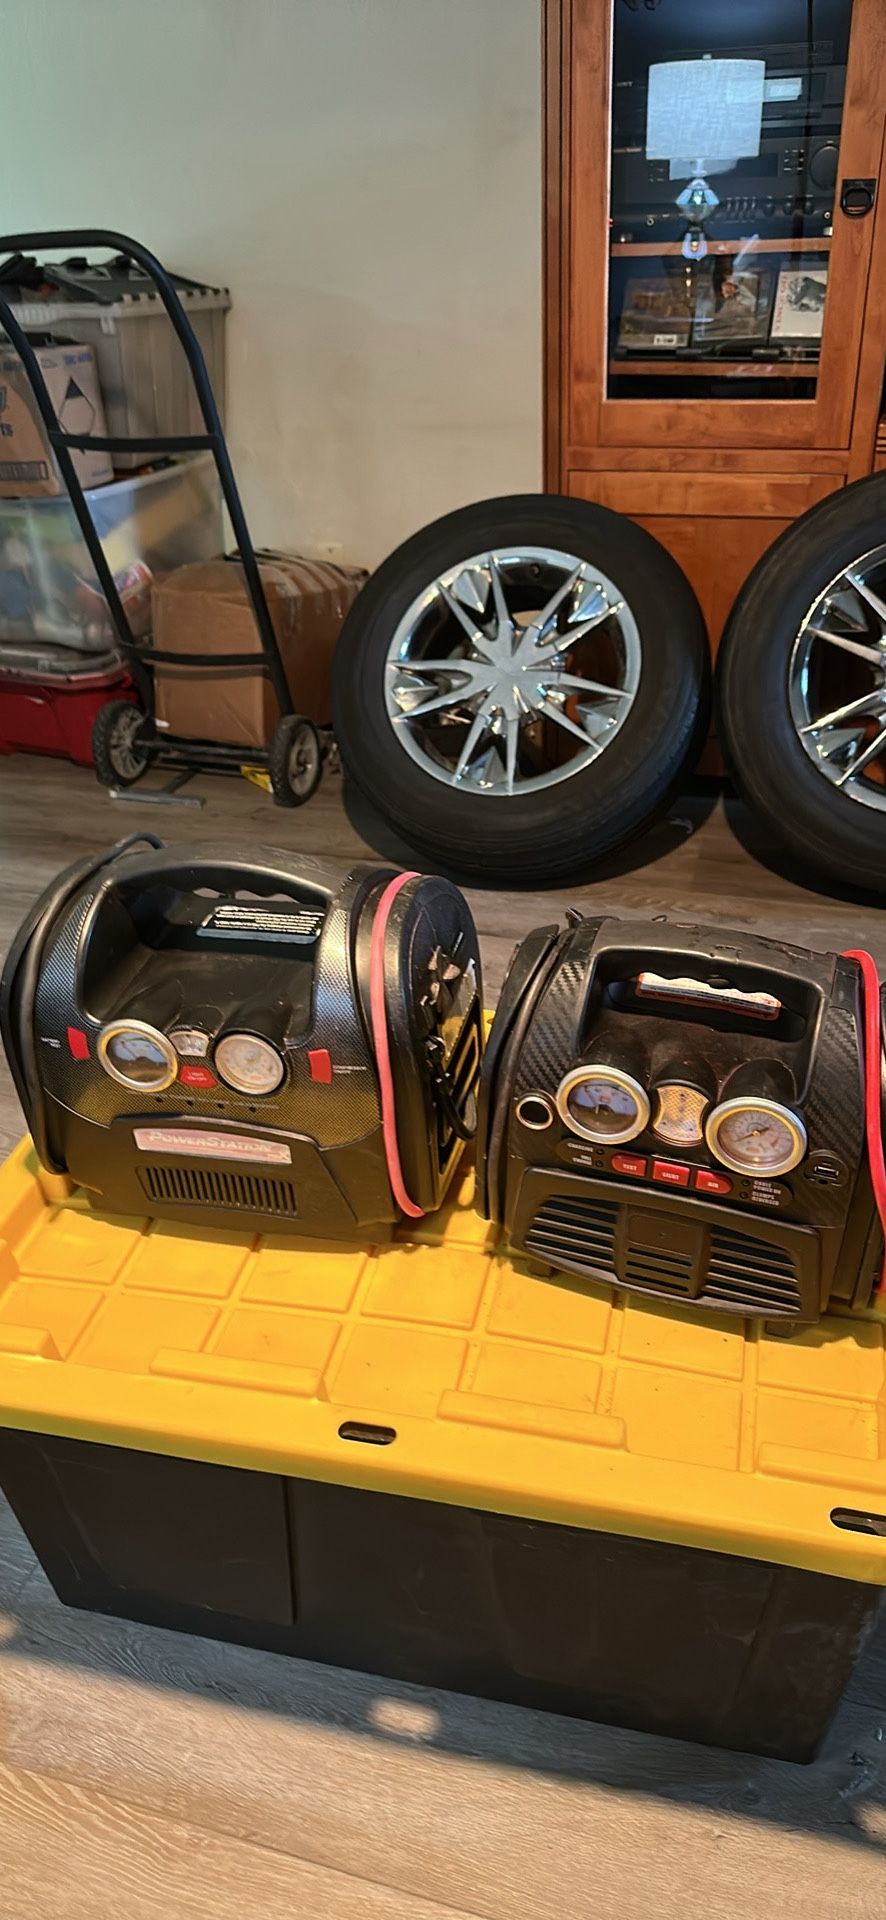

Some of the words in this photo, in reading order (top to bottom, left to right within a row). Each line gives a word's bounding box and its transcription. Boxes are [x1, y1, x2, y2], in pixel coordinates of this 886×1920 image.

[622, 1163, 638, 1171] TEST
[662, 1171, 680, 1181] LIGHT
[707, 1181, 719, 1189] AIR
